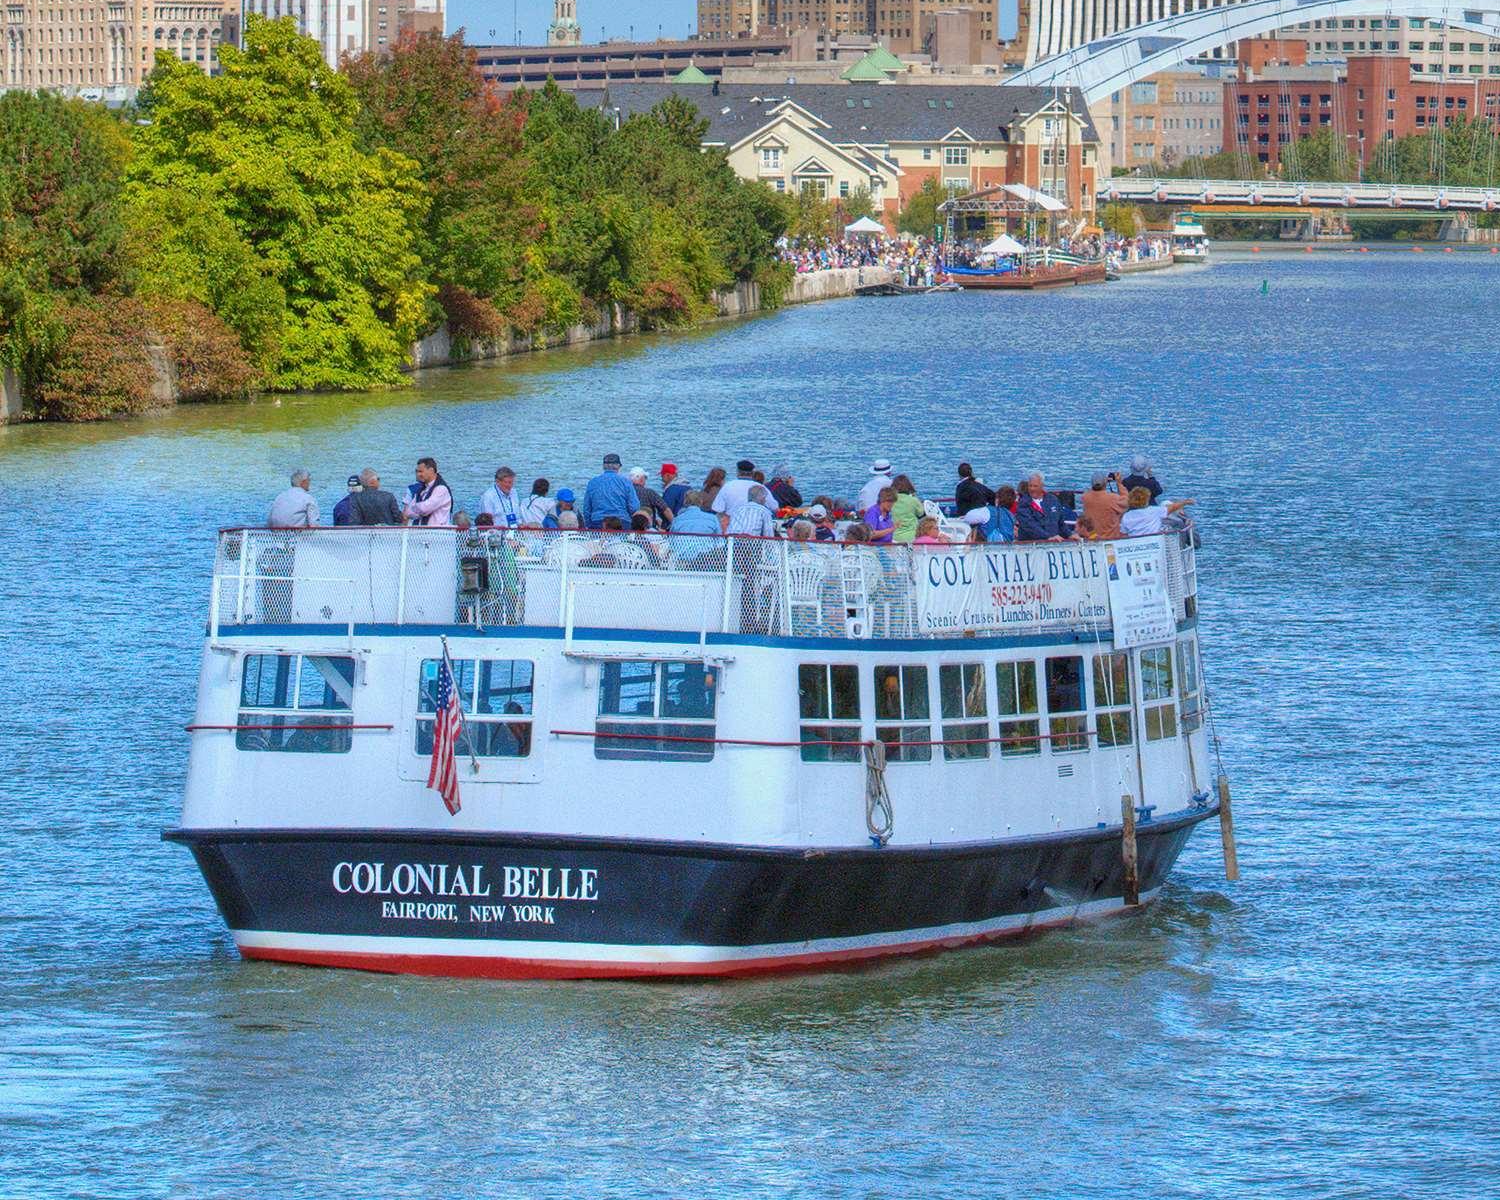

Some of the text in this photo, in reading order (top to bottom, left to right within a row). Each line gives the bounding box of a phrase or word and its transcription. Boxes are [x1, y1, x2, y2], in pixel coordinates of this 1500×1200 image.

[1046, 549, 1100, 580] BELLE
[926, 610, 958, 629] Scenic
[1001, 604, 1034, 623] Lunches
[1040, 603, 1072, 621] Dinners
[332, 861, 600, 901] COLONIAL BELLE
[381, 901, 555, 925] FAIRPORT, NEW YORK
